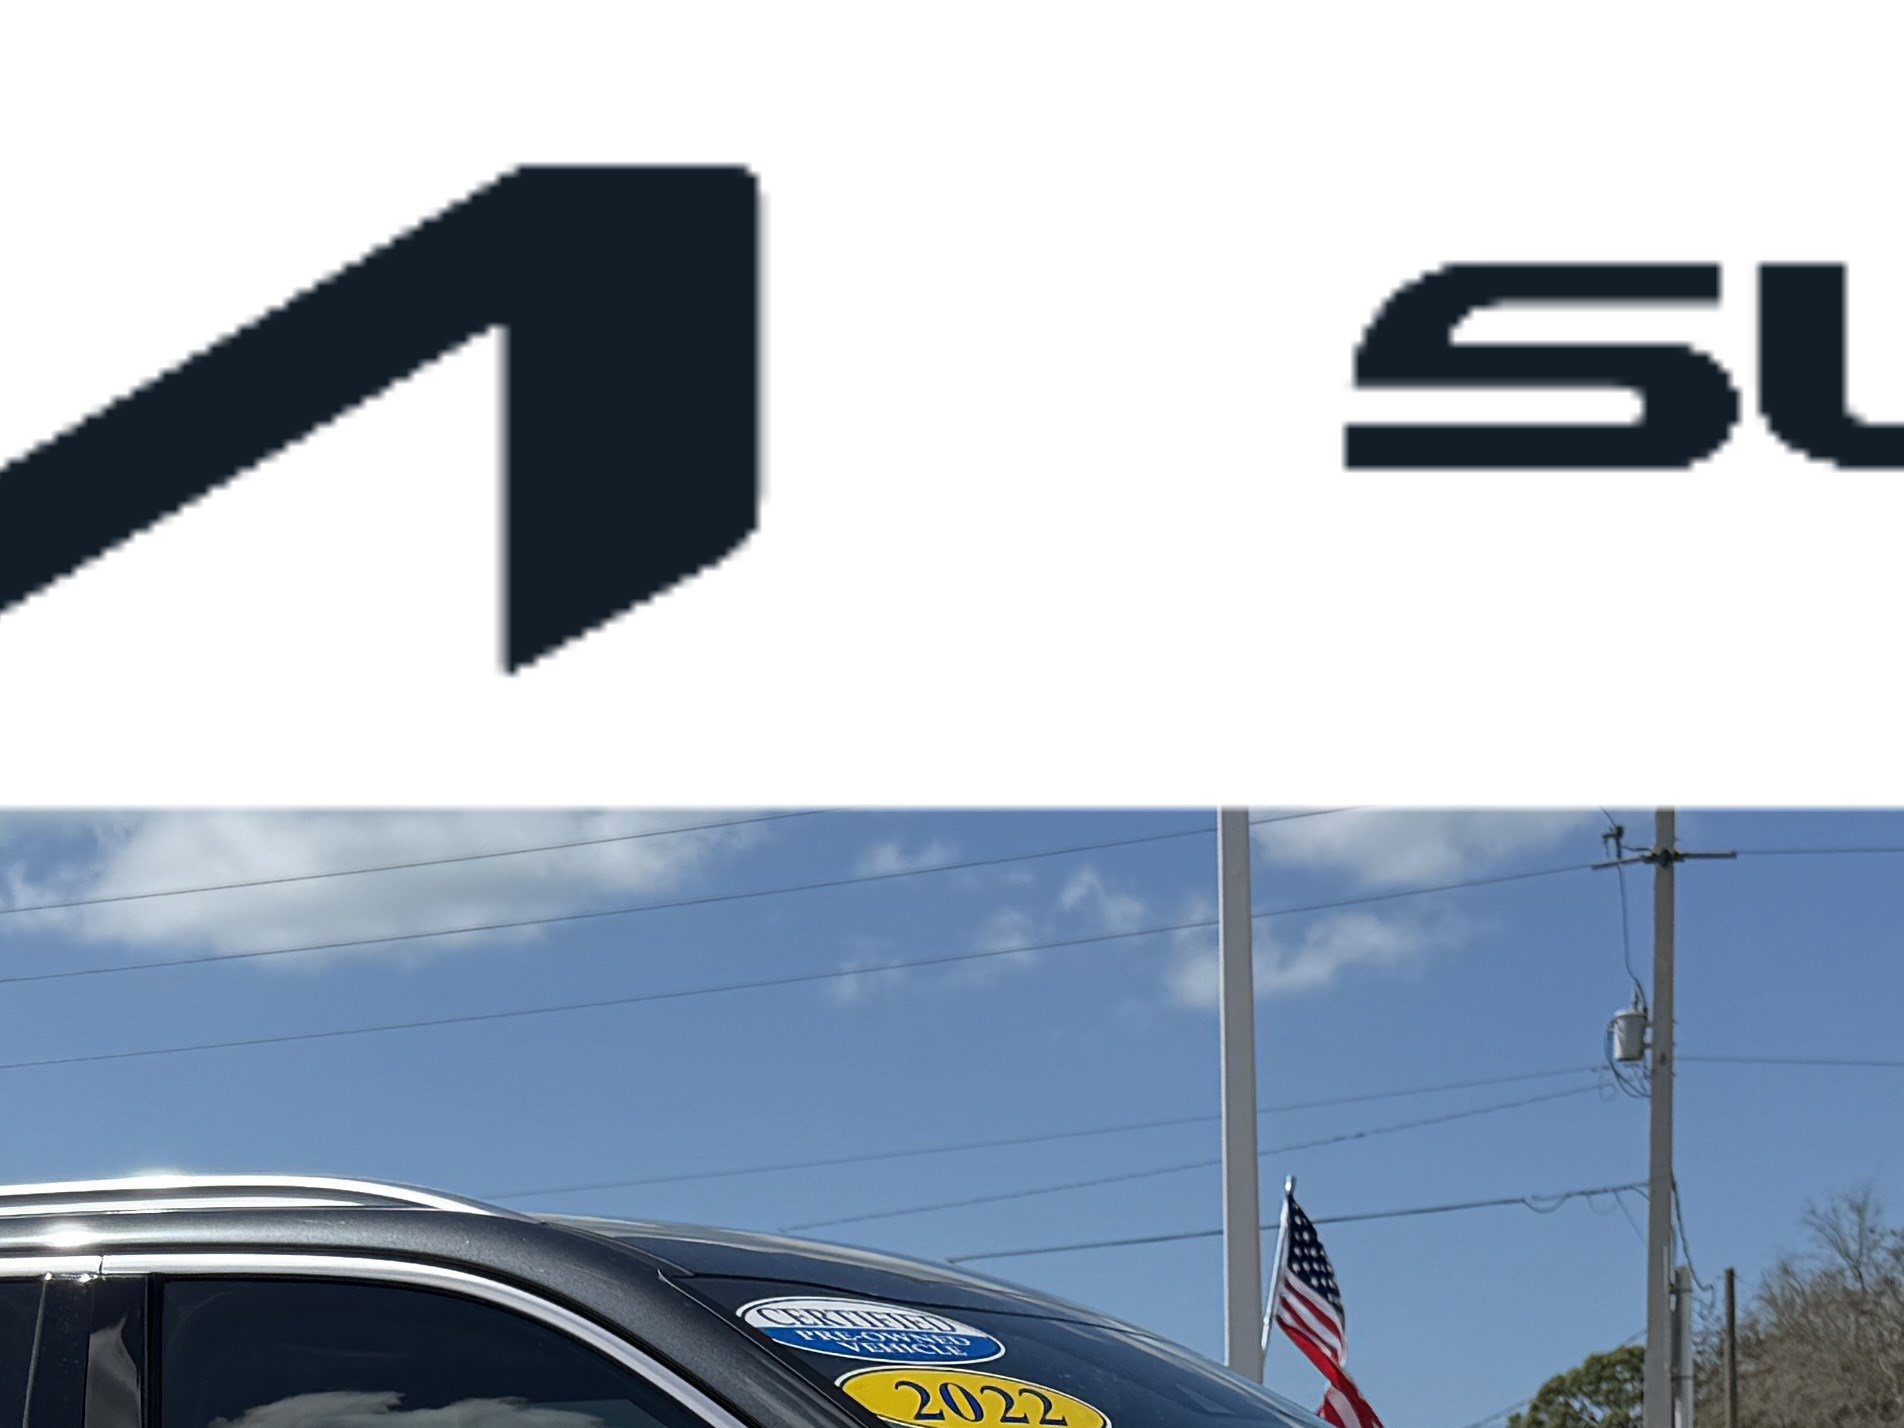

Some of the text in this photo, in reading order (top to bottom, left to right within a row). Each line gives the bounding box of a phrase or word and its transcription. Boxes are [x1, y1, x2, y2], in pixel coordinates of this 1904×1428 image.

[757, 1308, 957, 1332] CERTIFIED
[797, 1329, 971, 1347] PRE-OWNED
[837, 1342, 968, 1356] VEHICLE
[895, 1380, 1068, 1426] 2022
